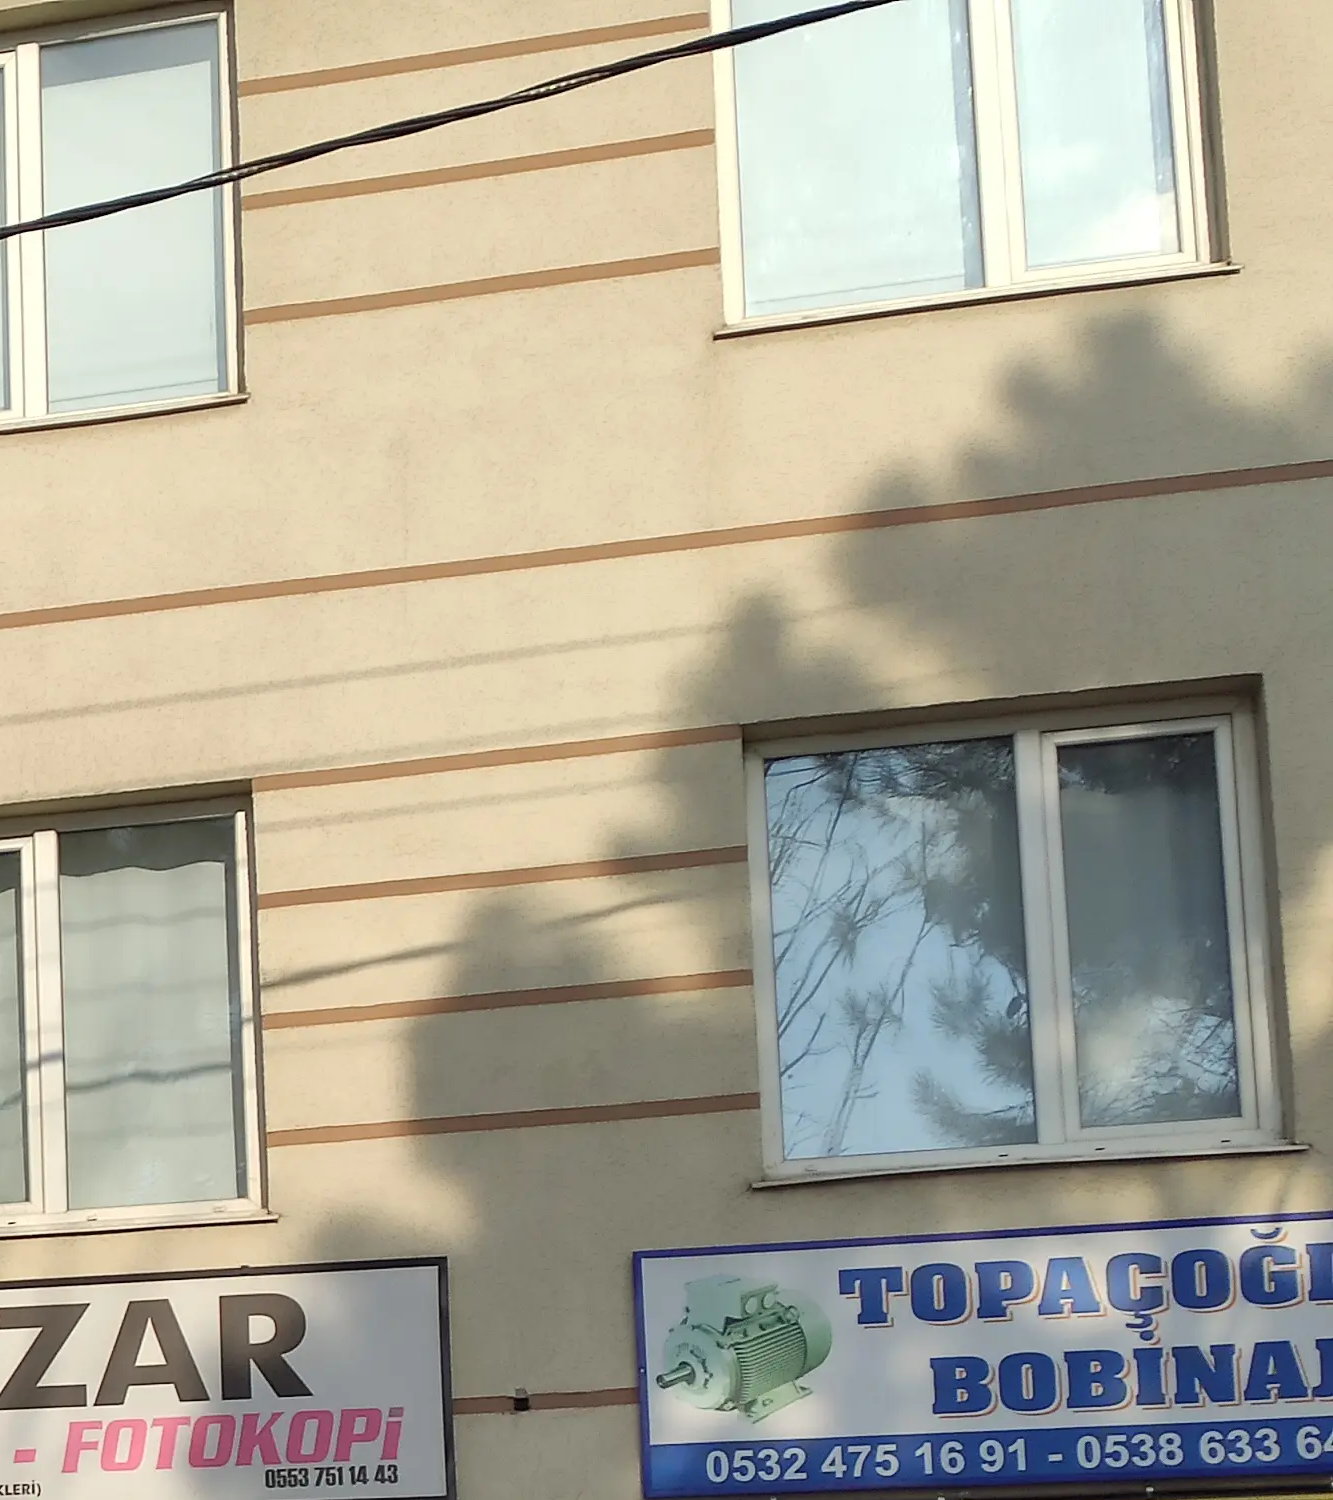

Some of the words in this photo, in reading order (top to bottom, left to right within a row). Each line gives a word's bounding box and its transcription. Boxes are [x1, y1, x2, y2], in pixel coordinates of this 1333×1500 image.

[705, 1447, 808, 1484] 0532
[820, 1443, 900, 1478] 475
[914, 1441, 965, 1475] 16
[979, 1437, 1027, 1472] 91
[1076, 1431, 1185, 1469] 0538
[1199, 1426, 1281, 1465] 633
[264, 1468, 310, 1489] 0553
[314, 1467, 345, 1487] 751
[349, 1466, 370, 1485] 14
[374, 1464, 399, 1485] 43
